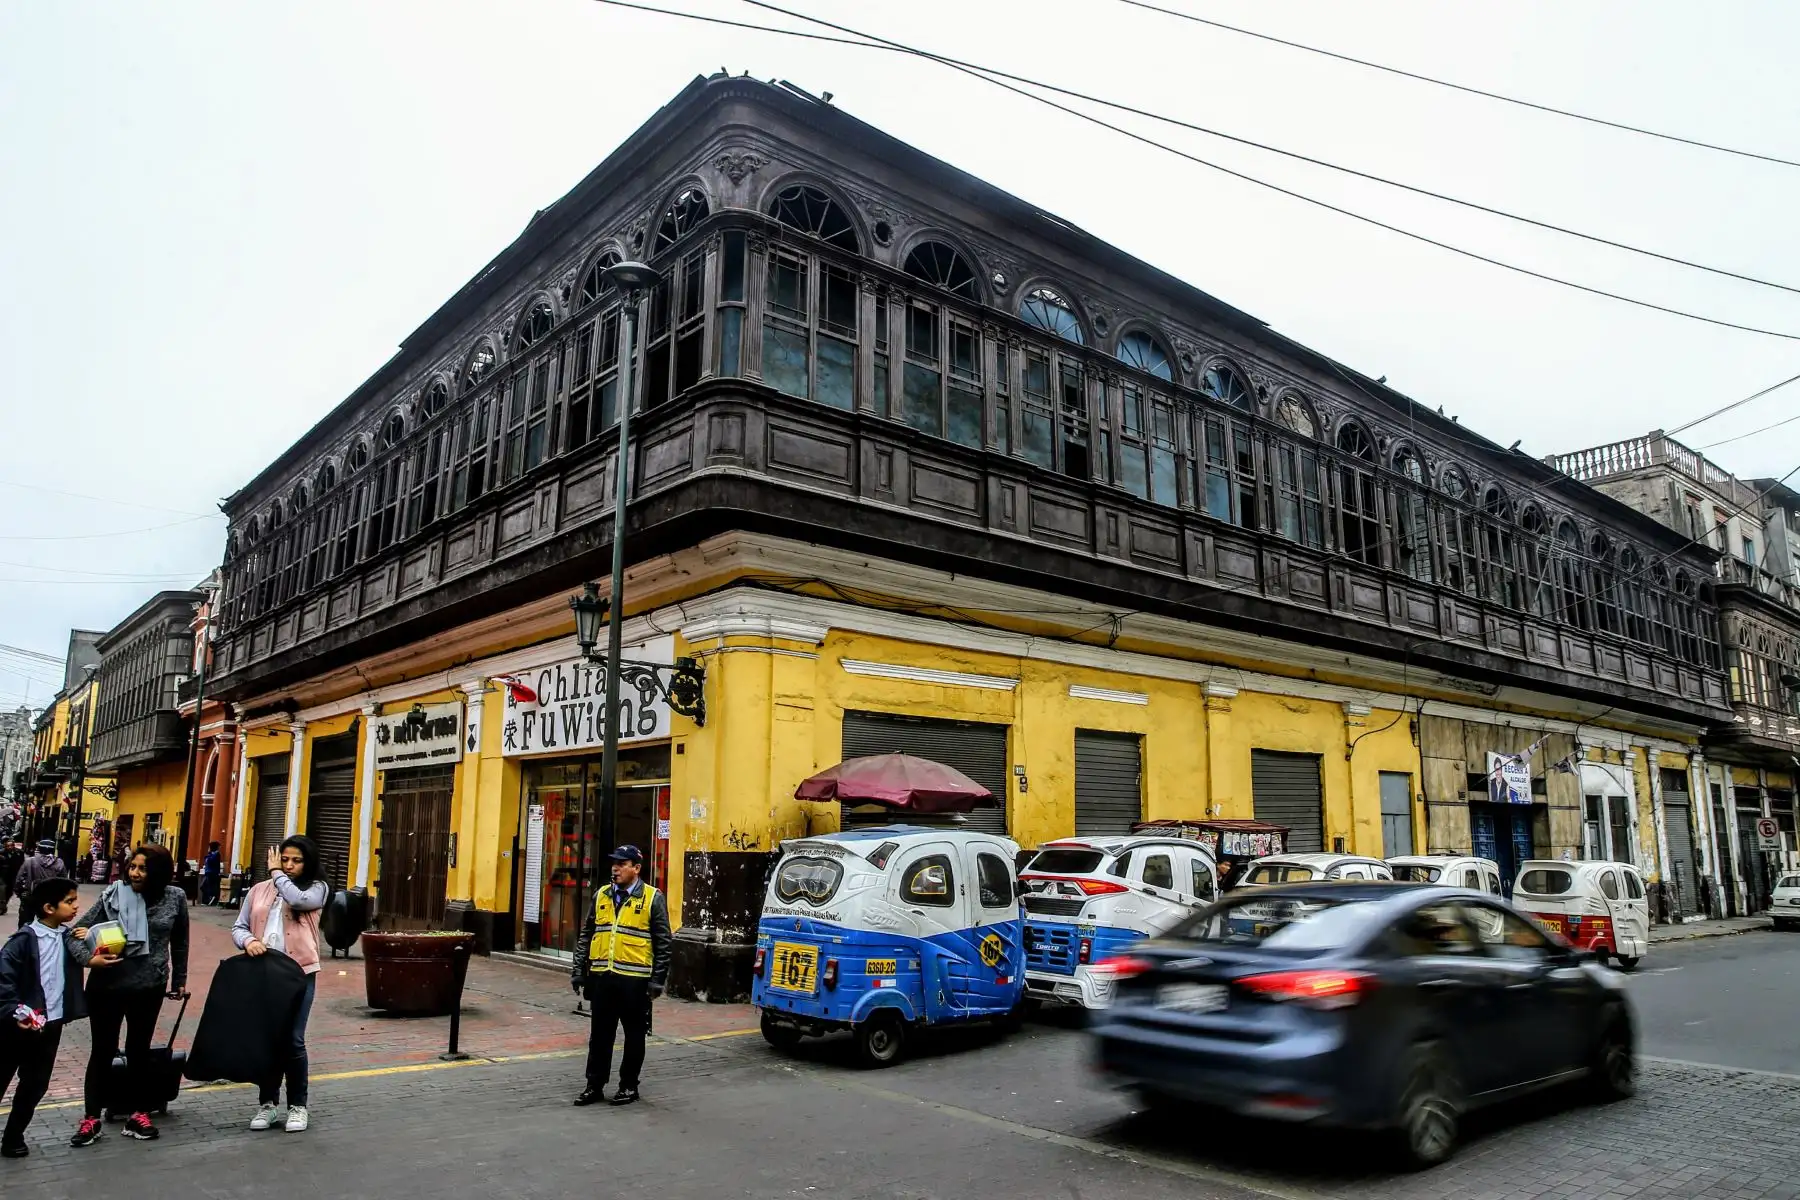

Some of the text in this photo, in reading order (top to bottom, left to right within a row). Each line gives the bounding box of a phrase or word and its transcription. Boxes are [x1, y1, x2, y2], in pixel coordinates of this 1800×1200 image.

[983, 940, 1000, 961] 167
[780, 949, 813, 988] 167
[867, 961, 896, 975] 6360-2C
